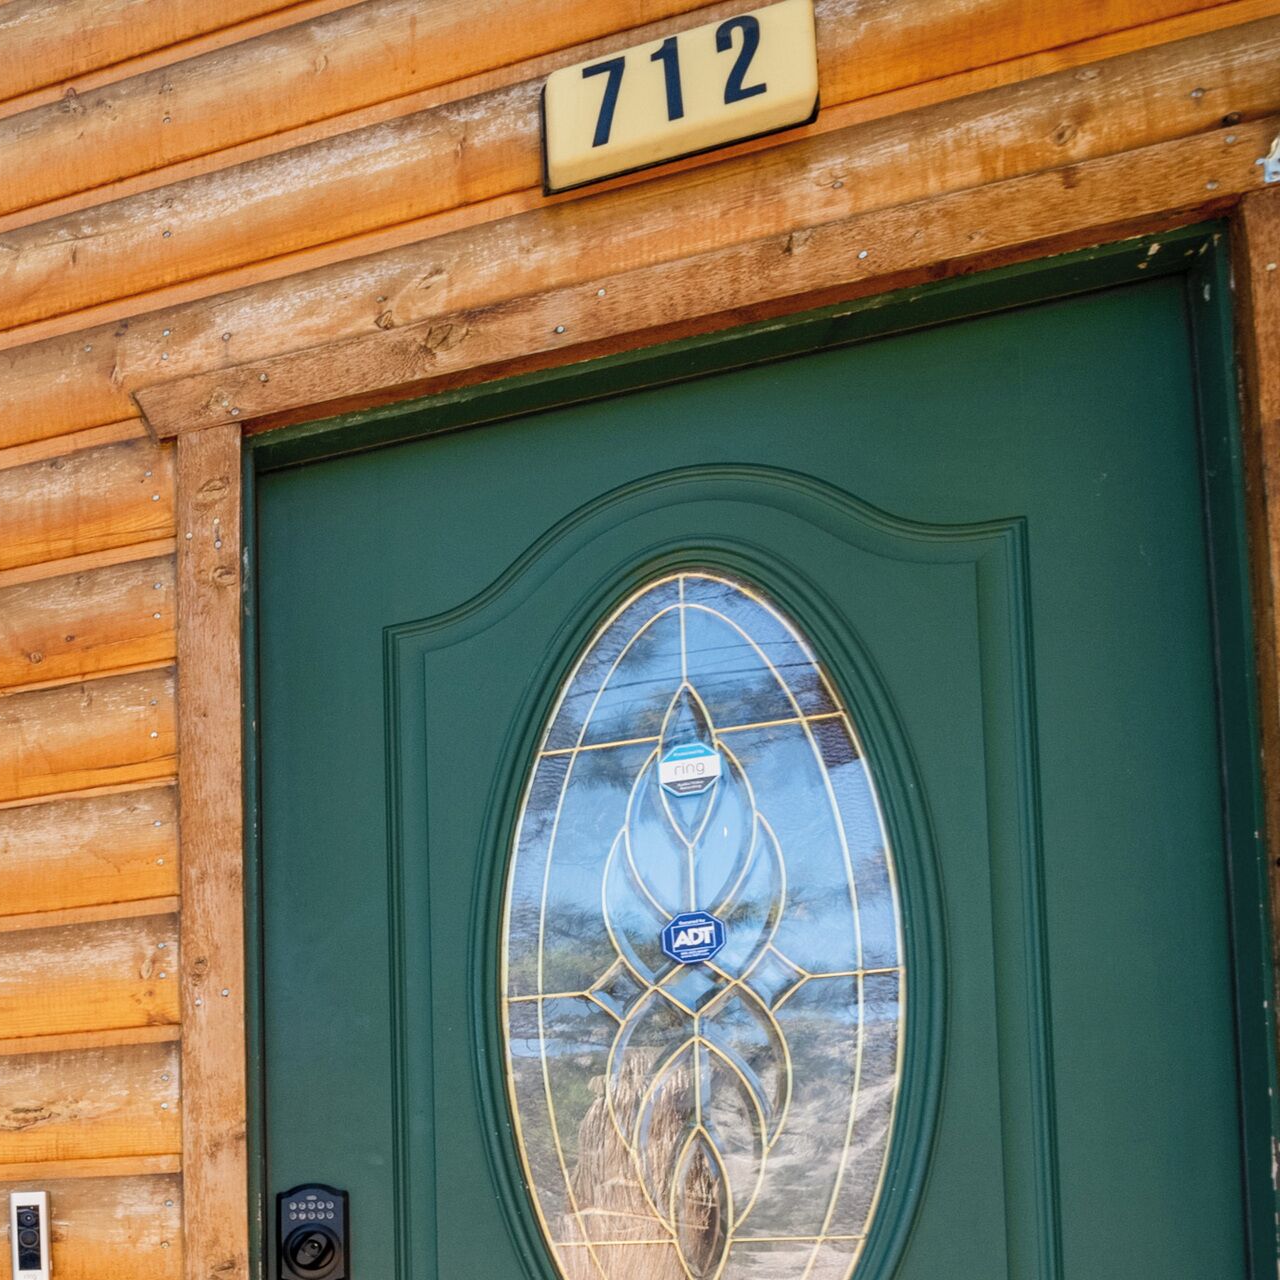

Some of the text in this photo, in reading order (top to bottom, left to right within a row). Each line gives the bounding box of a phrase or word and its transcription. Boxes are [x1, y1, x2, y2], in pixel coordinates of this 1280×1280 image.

[581, 15, 768, 148] 712
[674, 762, 705, 776] ring
[673, 926, 714, 948] ADT
